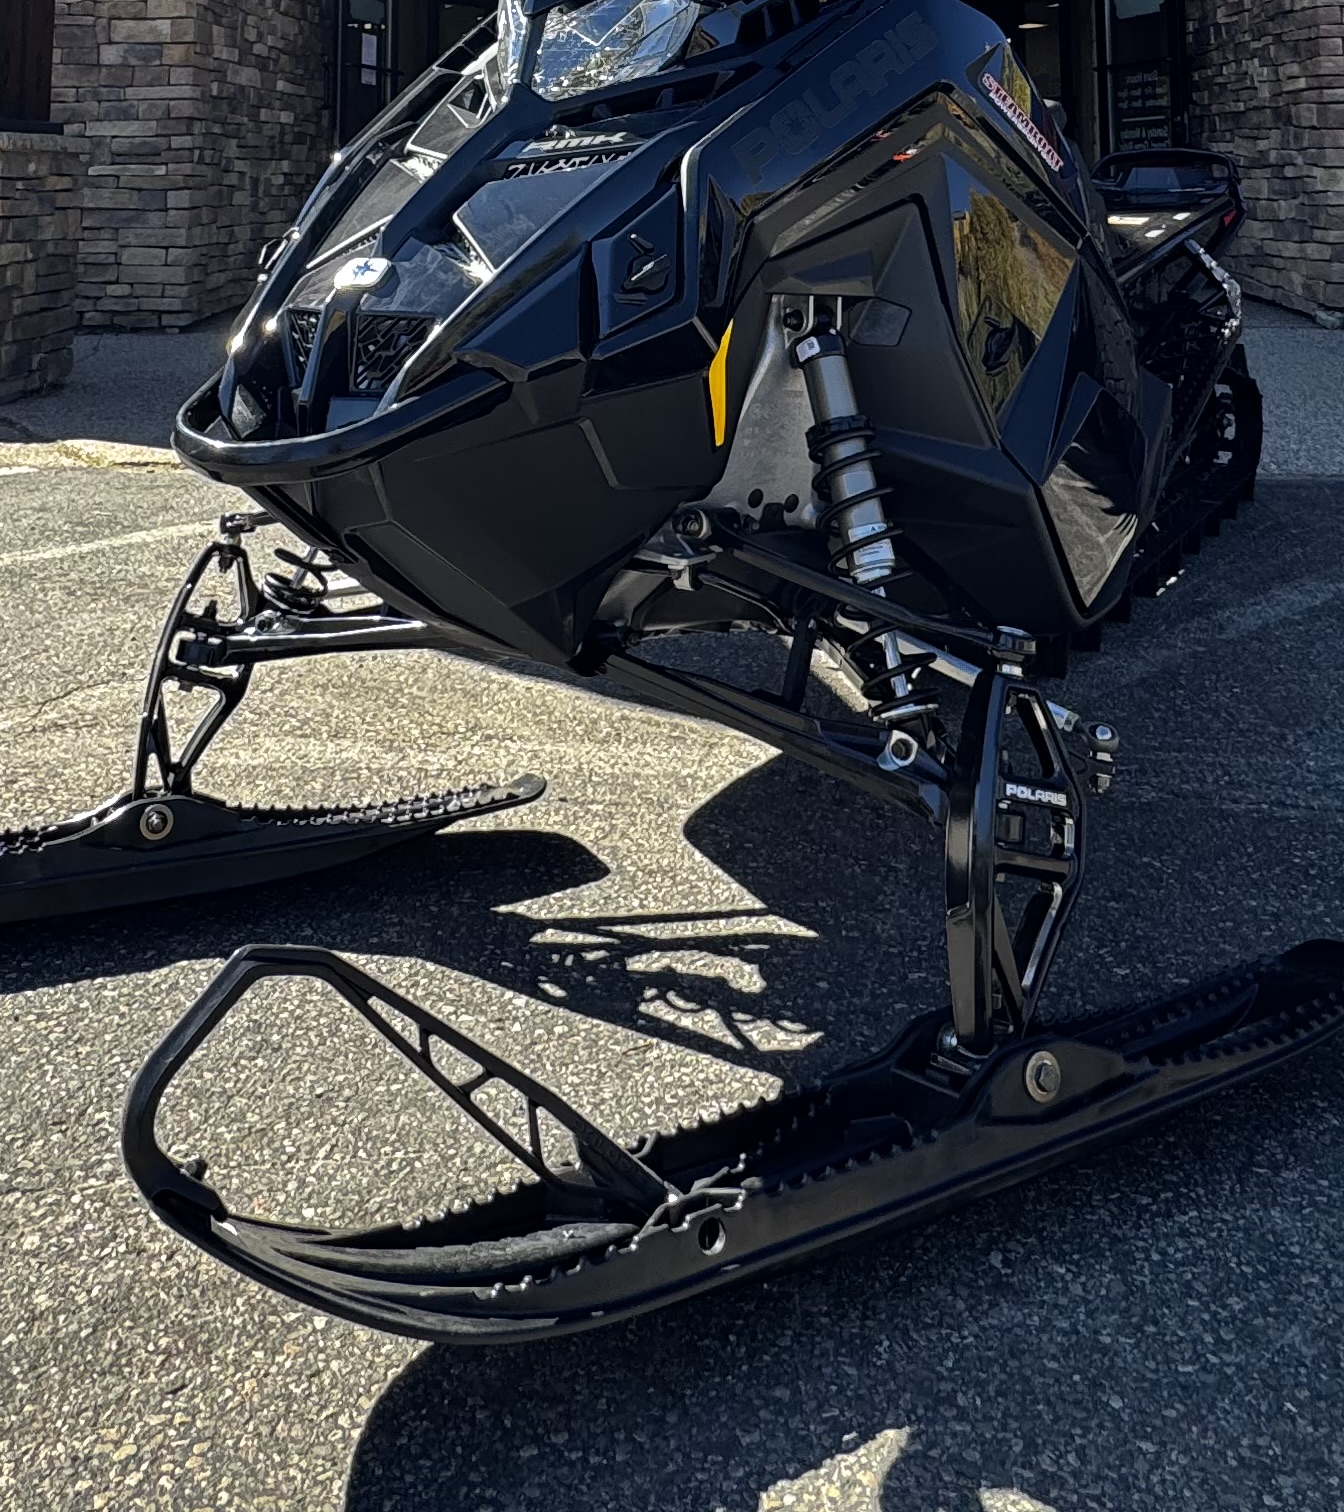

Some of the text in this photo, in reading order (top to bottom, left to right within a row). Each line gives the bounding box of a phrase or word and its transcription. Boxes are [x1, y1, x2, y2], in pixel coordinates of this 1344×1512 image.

[731, 10, 938, 186] POLARIS
[981, 71, 1065, 168] STEAMBOAT
[1006, 783, 1067, 807] POLARIS
